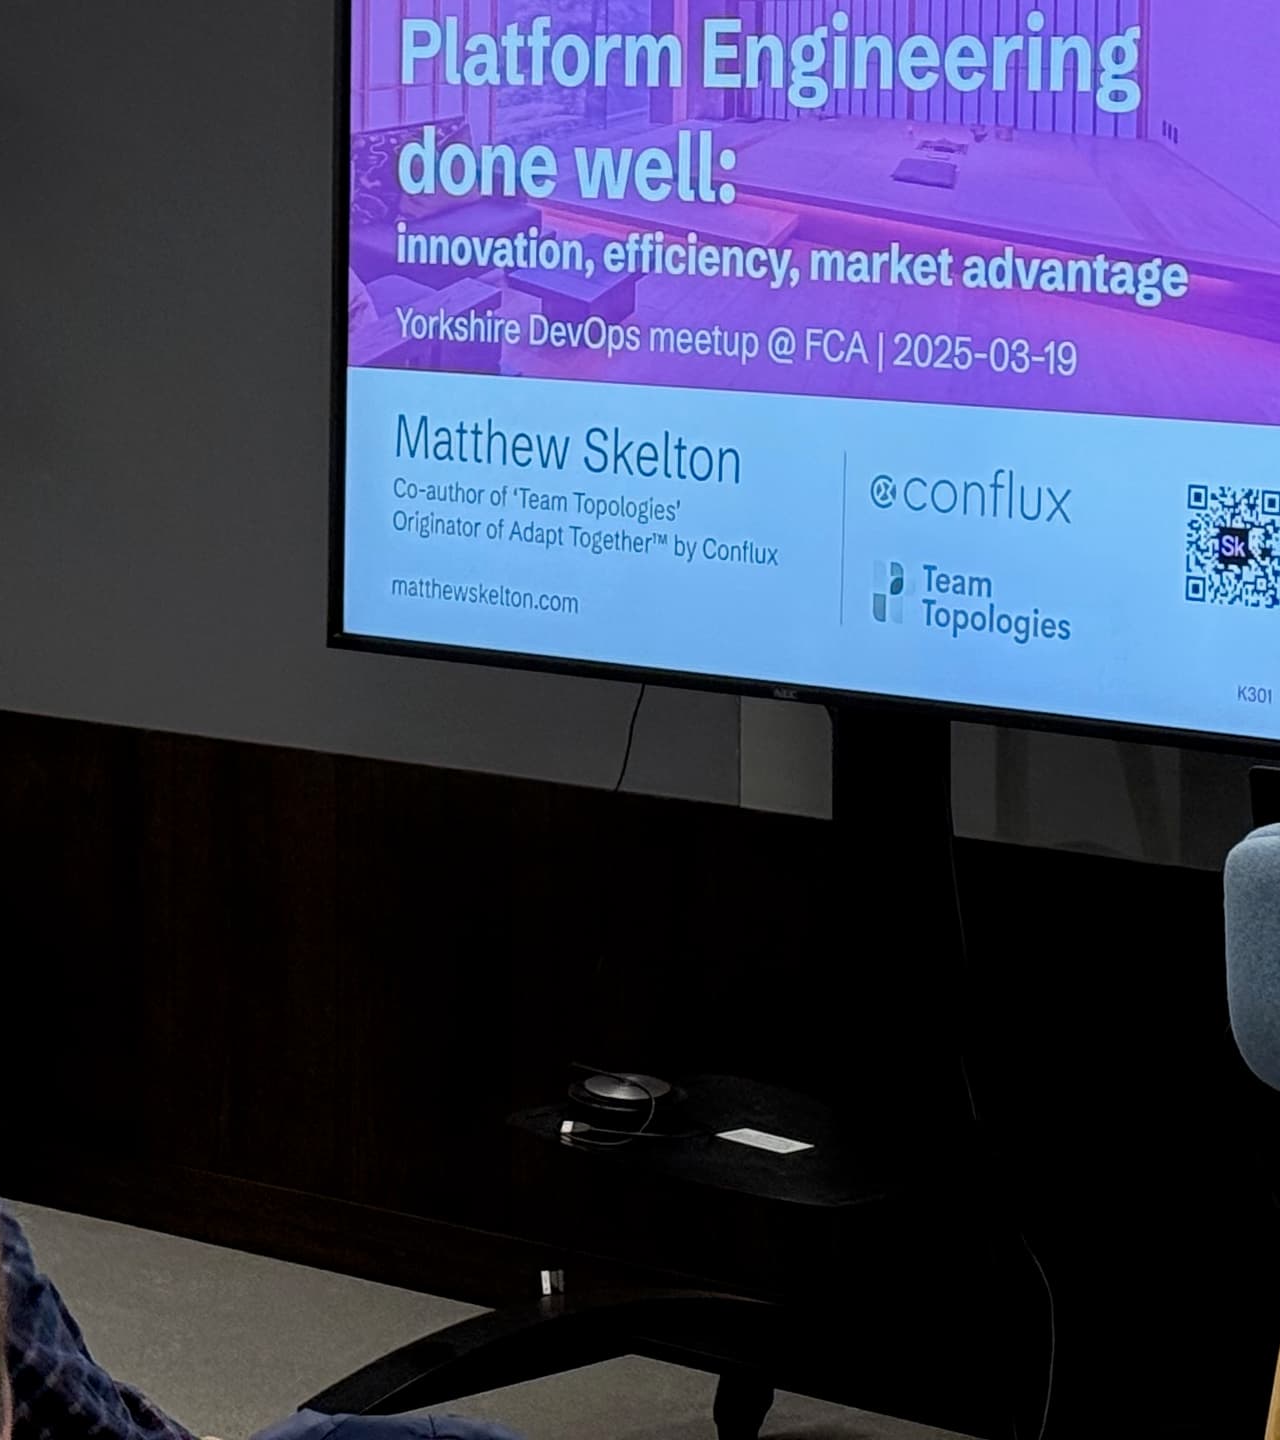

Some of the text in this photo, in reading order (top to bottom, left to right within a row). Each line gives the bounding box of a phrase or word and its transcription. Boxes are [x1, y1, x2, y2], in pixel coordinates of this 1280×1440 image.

[401, 10, 1142, 113] Platform Engineering
[398, 125, 736, 204] done well:
[396, 221, 1189, 308] innovation, efficiency, market advantage
[395, 305, 521, 345] Yorkshire
[529, 314, 641, 358] DevOps
[649, 324, 759, 365] meetup
[768, 326, 797, 364] @
[805, 328, 869, 364] FCA
[893, 332, 1078, 377] 2025-03-19
[395, 413, 741, 484] Matthew Skelton
[393, 477, 485, 506] Co-author
[490, 485, 509, 507] of
[392, 510, 481, 538] Originator
[486, 518, 505, 540] of
[509, 521, 564, 550] Adapt
[674, 535, 697, 563] by
[702, 537, 779, 566] Conflux
[1221, 534, 1246, 557] Sk
[391, 577, 579, 614] matthewskelton.com
[923, 564, 992, 598] Team
[922, 598, 1071, 644] Topologies
[1237, 685, 1273, 705] K301
